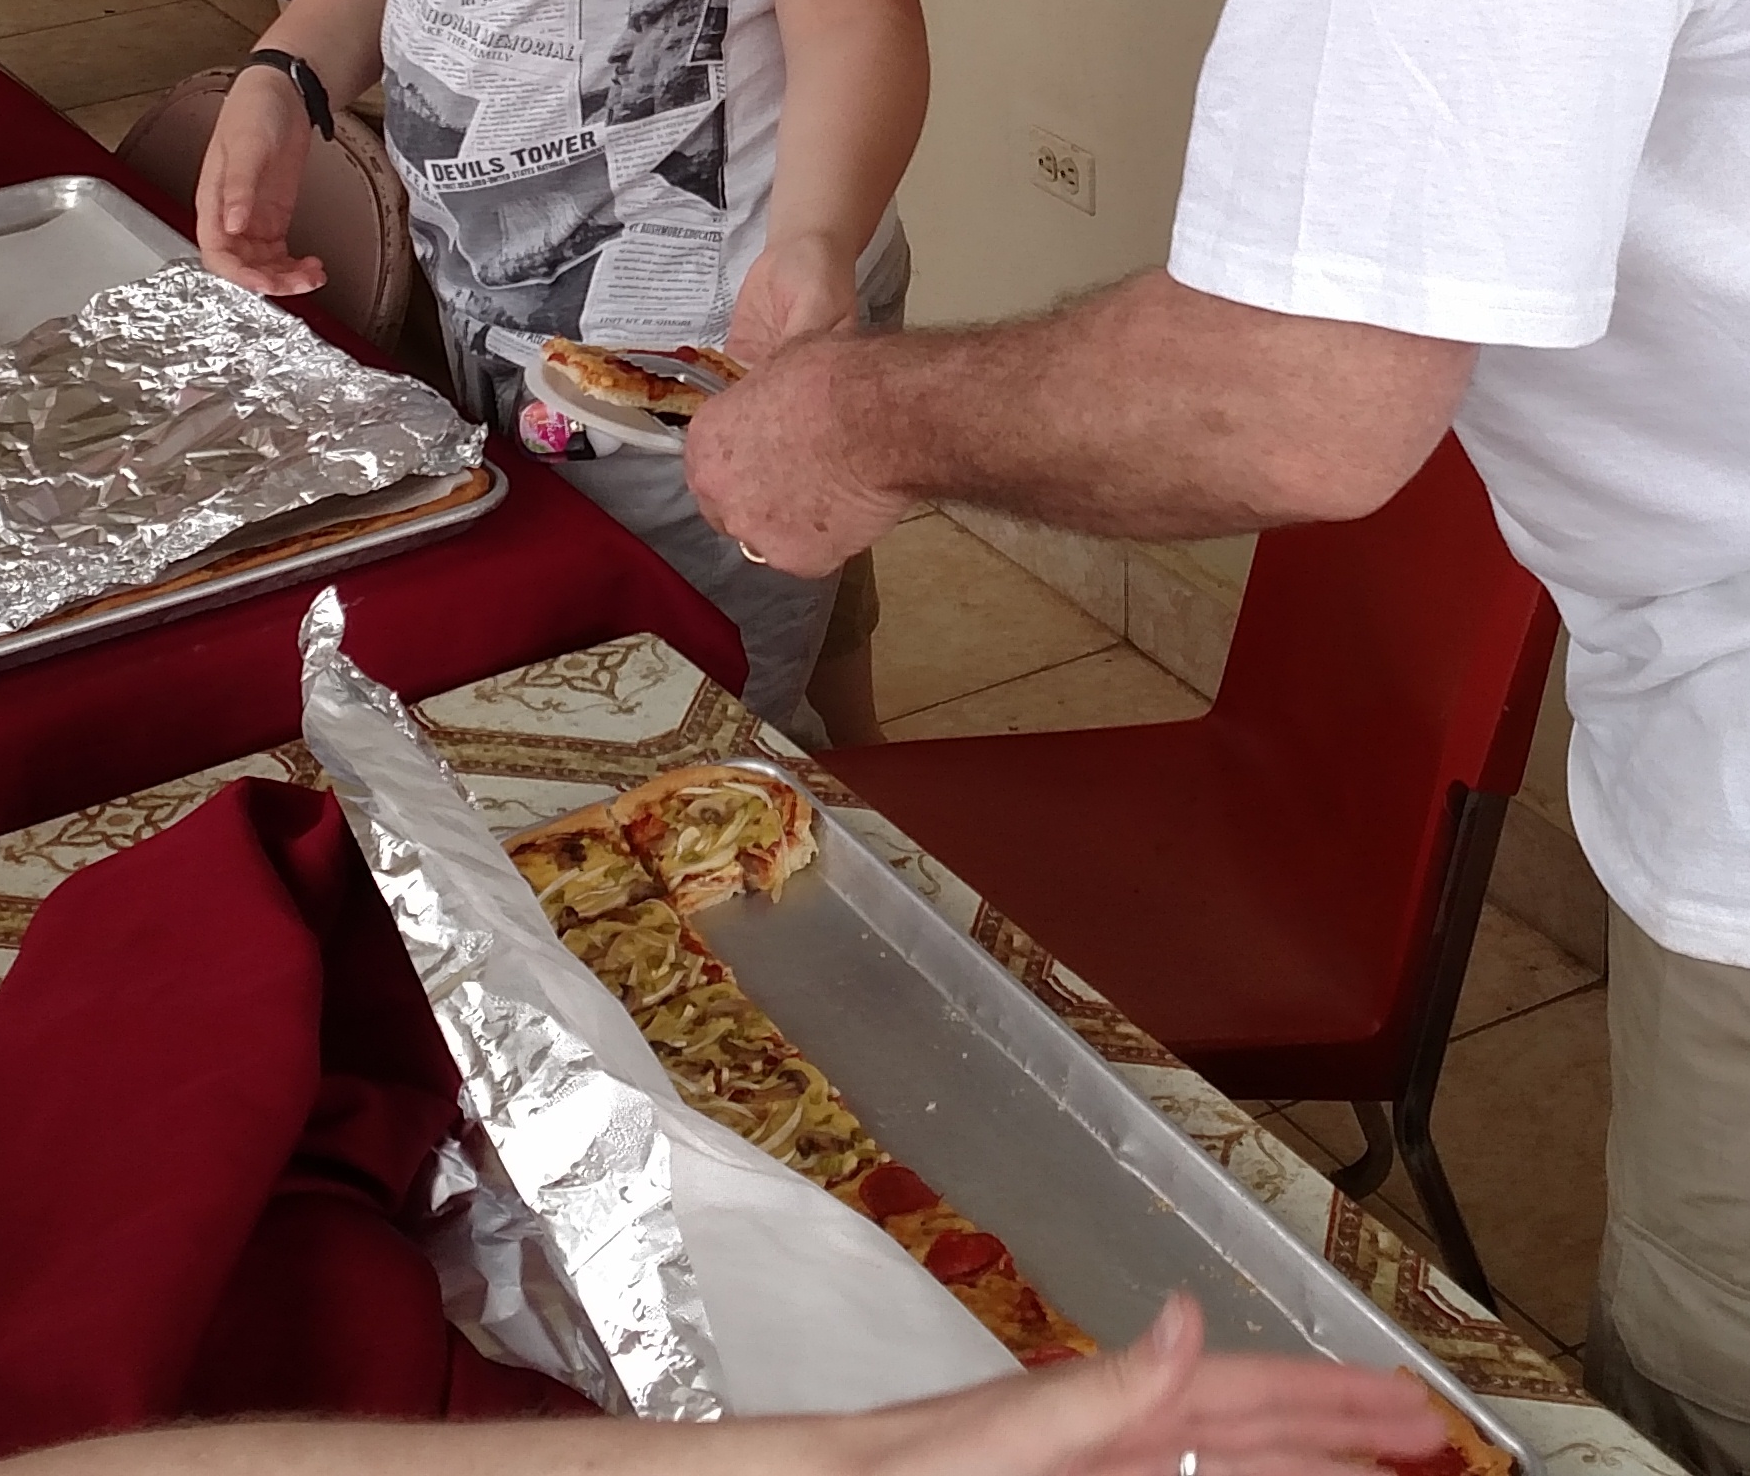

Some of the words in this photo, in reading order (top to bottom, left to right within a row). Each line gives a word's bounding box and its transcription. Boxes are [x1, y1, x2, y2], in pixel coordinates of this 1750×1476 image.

[446, 32, 467, 46] THE
[469, 45, 513, 62] FAMILY
[481, 29, 575, 61] MEMORIAL
[430, 157, 505, 182] DEVILS
[510, 131, 597, 167] TOWER
